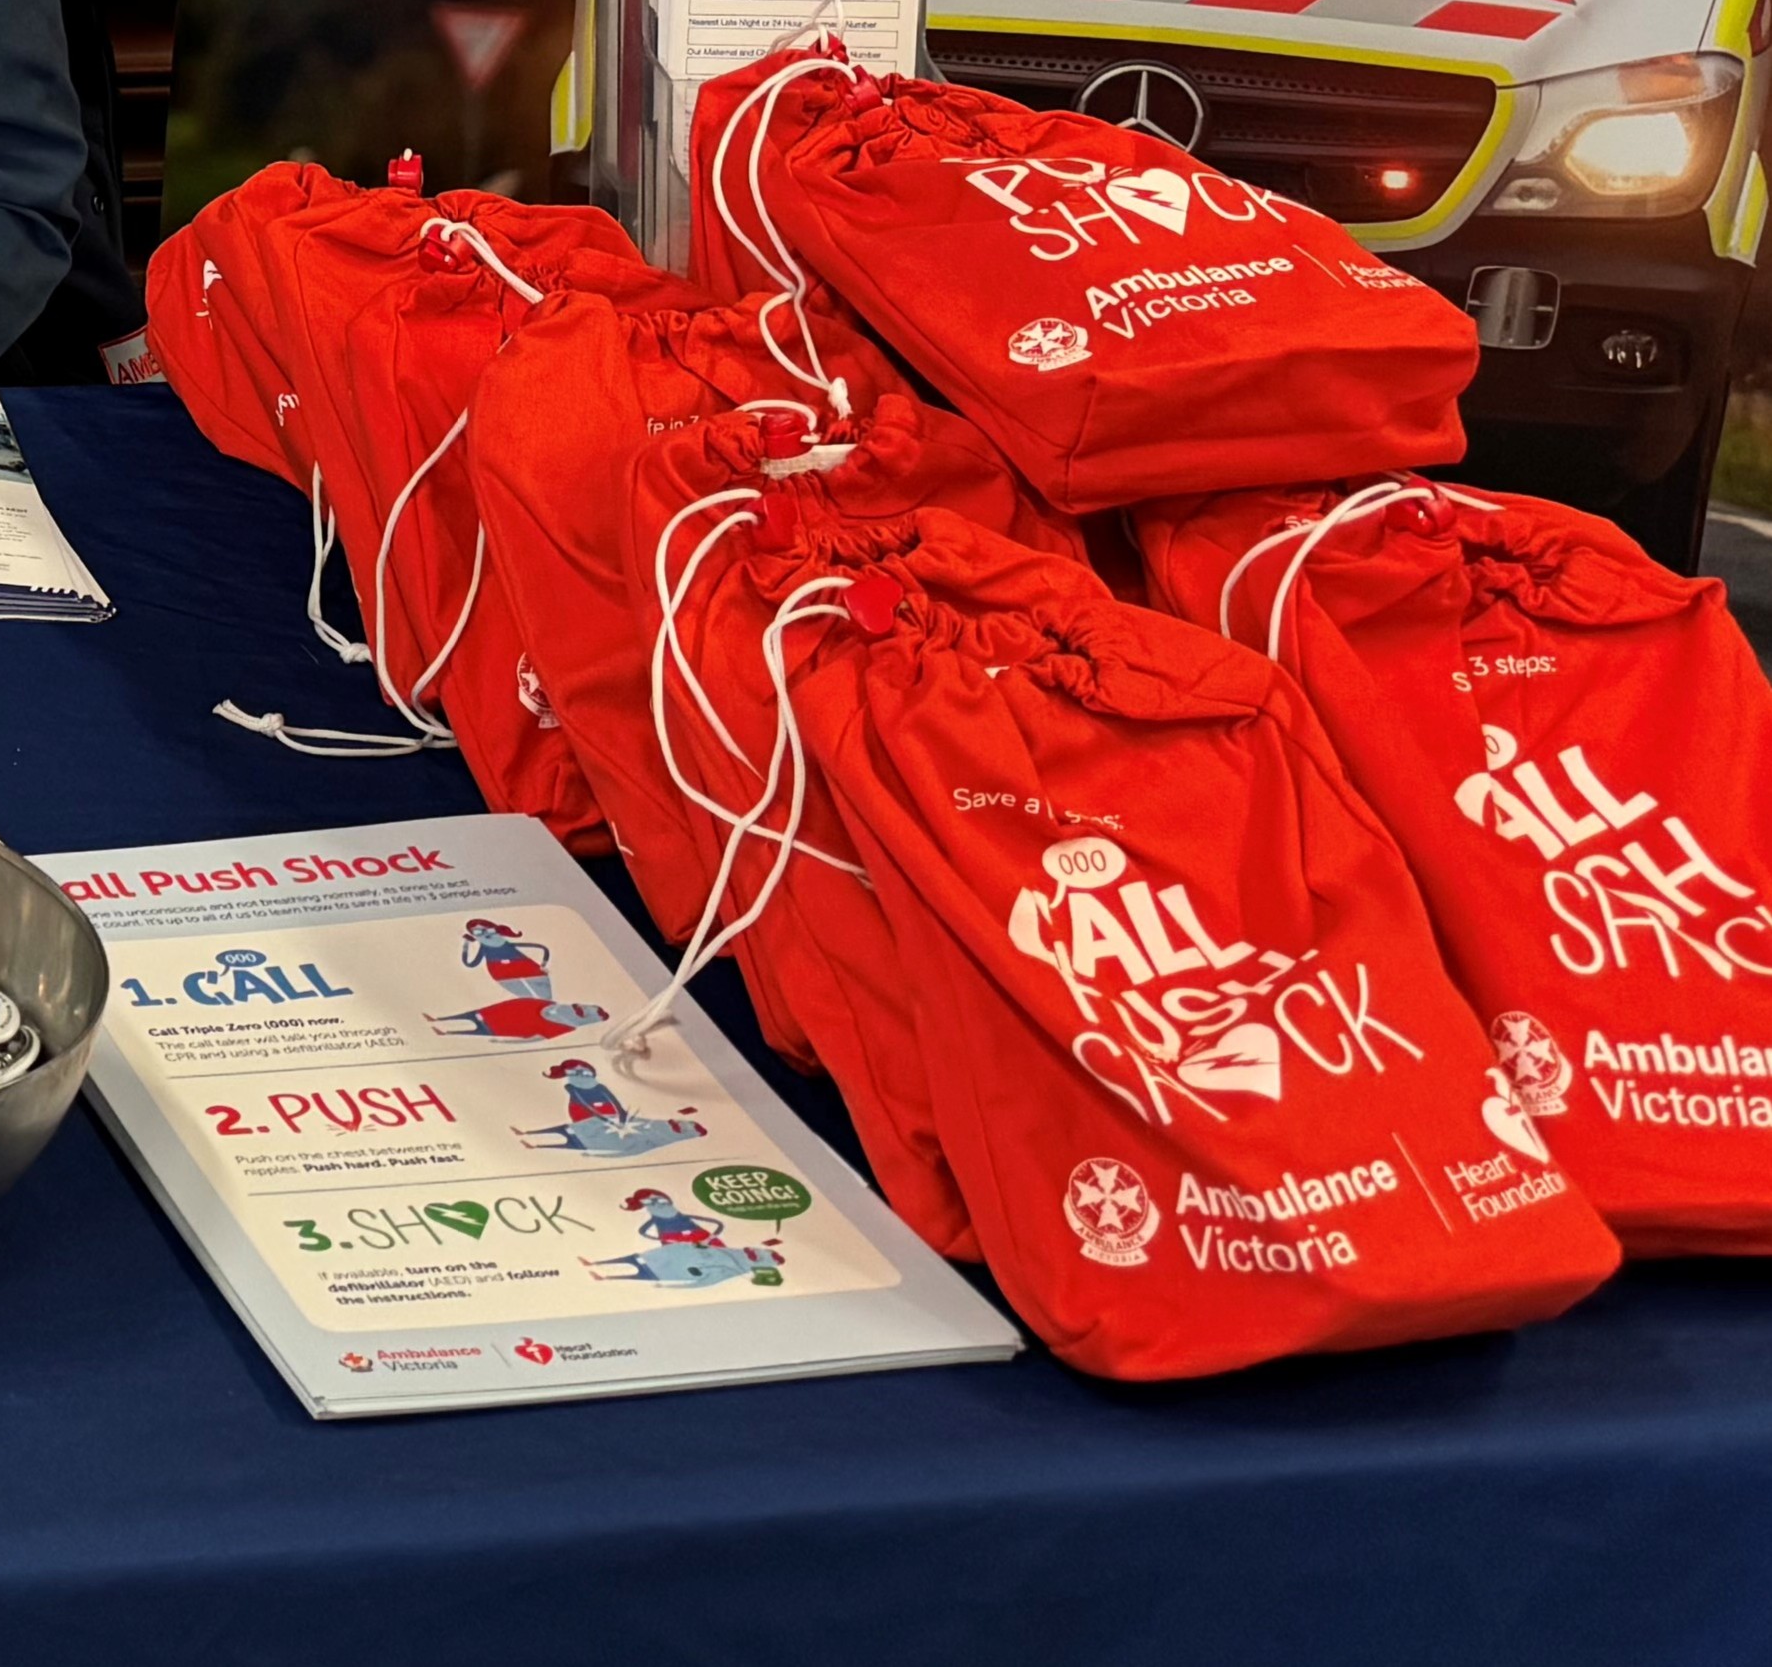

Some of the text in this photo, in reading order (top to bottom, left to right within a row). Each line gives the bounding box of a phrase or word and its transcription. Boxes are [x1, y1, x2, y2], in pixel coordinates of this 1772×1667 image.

[1085, 253, 1295, 319] Ambulance
[1102, 286, 1257, 340] Victoria
[1469, 654, 1557, 678] 3 steps:
[59, 846, 455, 903] all Push Shock
[1058, 848, 1108, 875] 000
[224, 952, 258, 966] 000
[121, 963, 353, 1007] 1. CALL
[148, 1026, 178, 1037] Call
[182, 1023, 224, 1035] Triple
[226, 1021, 262, 1032] Zero
[308, 1016, 345, 1026] now.
[205, 1083, 459, 1136] 2. PUSH
[1589, 1076, 1772, 1128] Victoria
[704, 1174, 768, 1191] KEEP
[1176, 1155, 1399, 1217] Ambulance
[1444, 1150, 1516, 1192] Heart
[709, 1183, 797, 1206] GOING!
[284, 1220, 354, 1252] 3.
[1179, 1223, 1357, 1274] Victoria
[377, 1346, 482, 1362] Ambulance
[382, 1360, 459, 1372] Victoria
